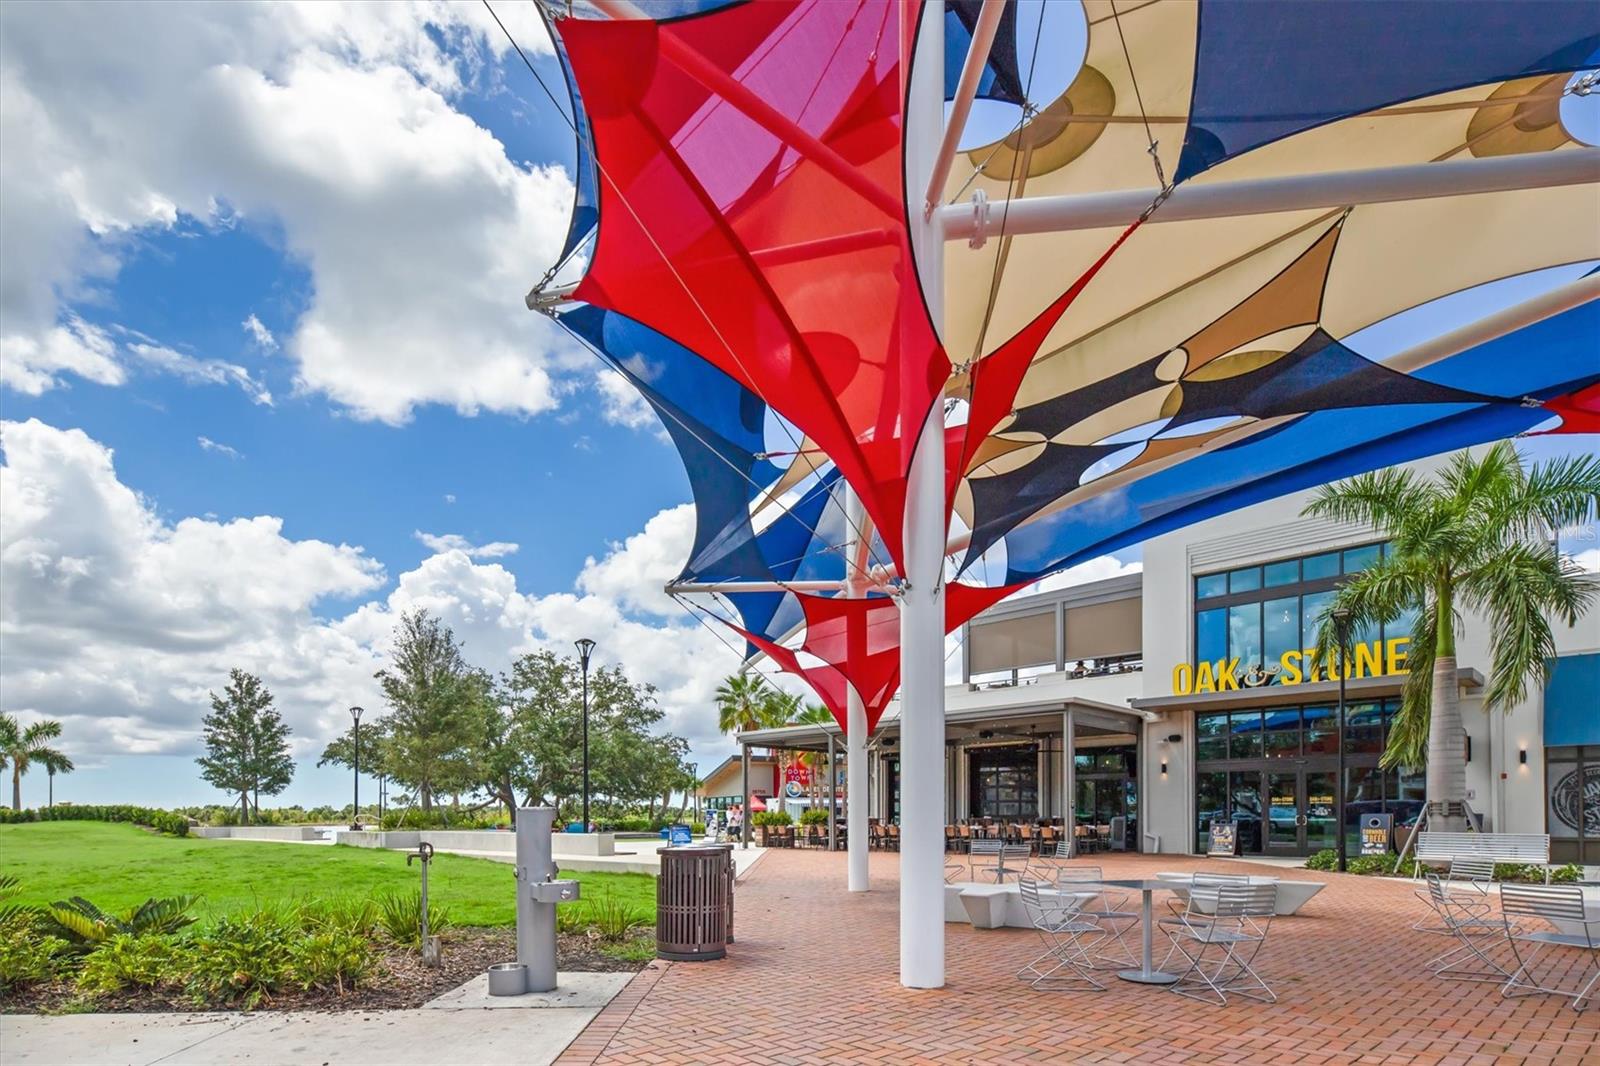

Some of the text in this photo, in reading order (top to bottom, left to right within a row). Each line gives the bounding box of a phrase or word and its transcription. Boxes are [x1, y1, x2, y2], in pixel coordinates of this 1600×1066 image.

[1172, 637, 1411, 696] OAK & STONE
[1369, 834, 1387, 843] BEER
